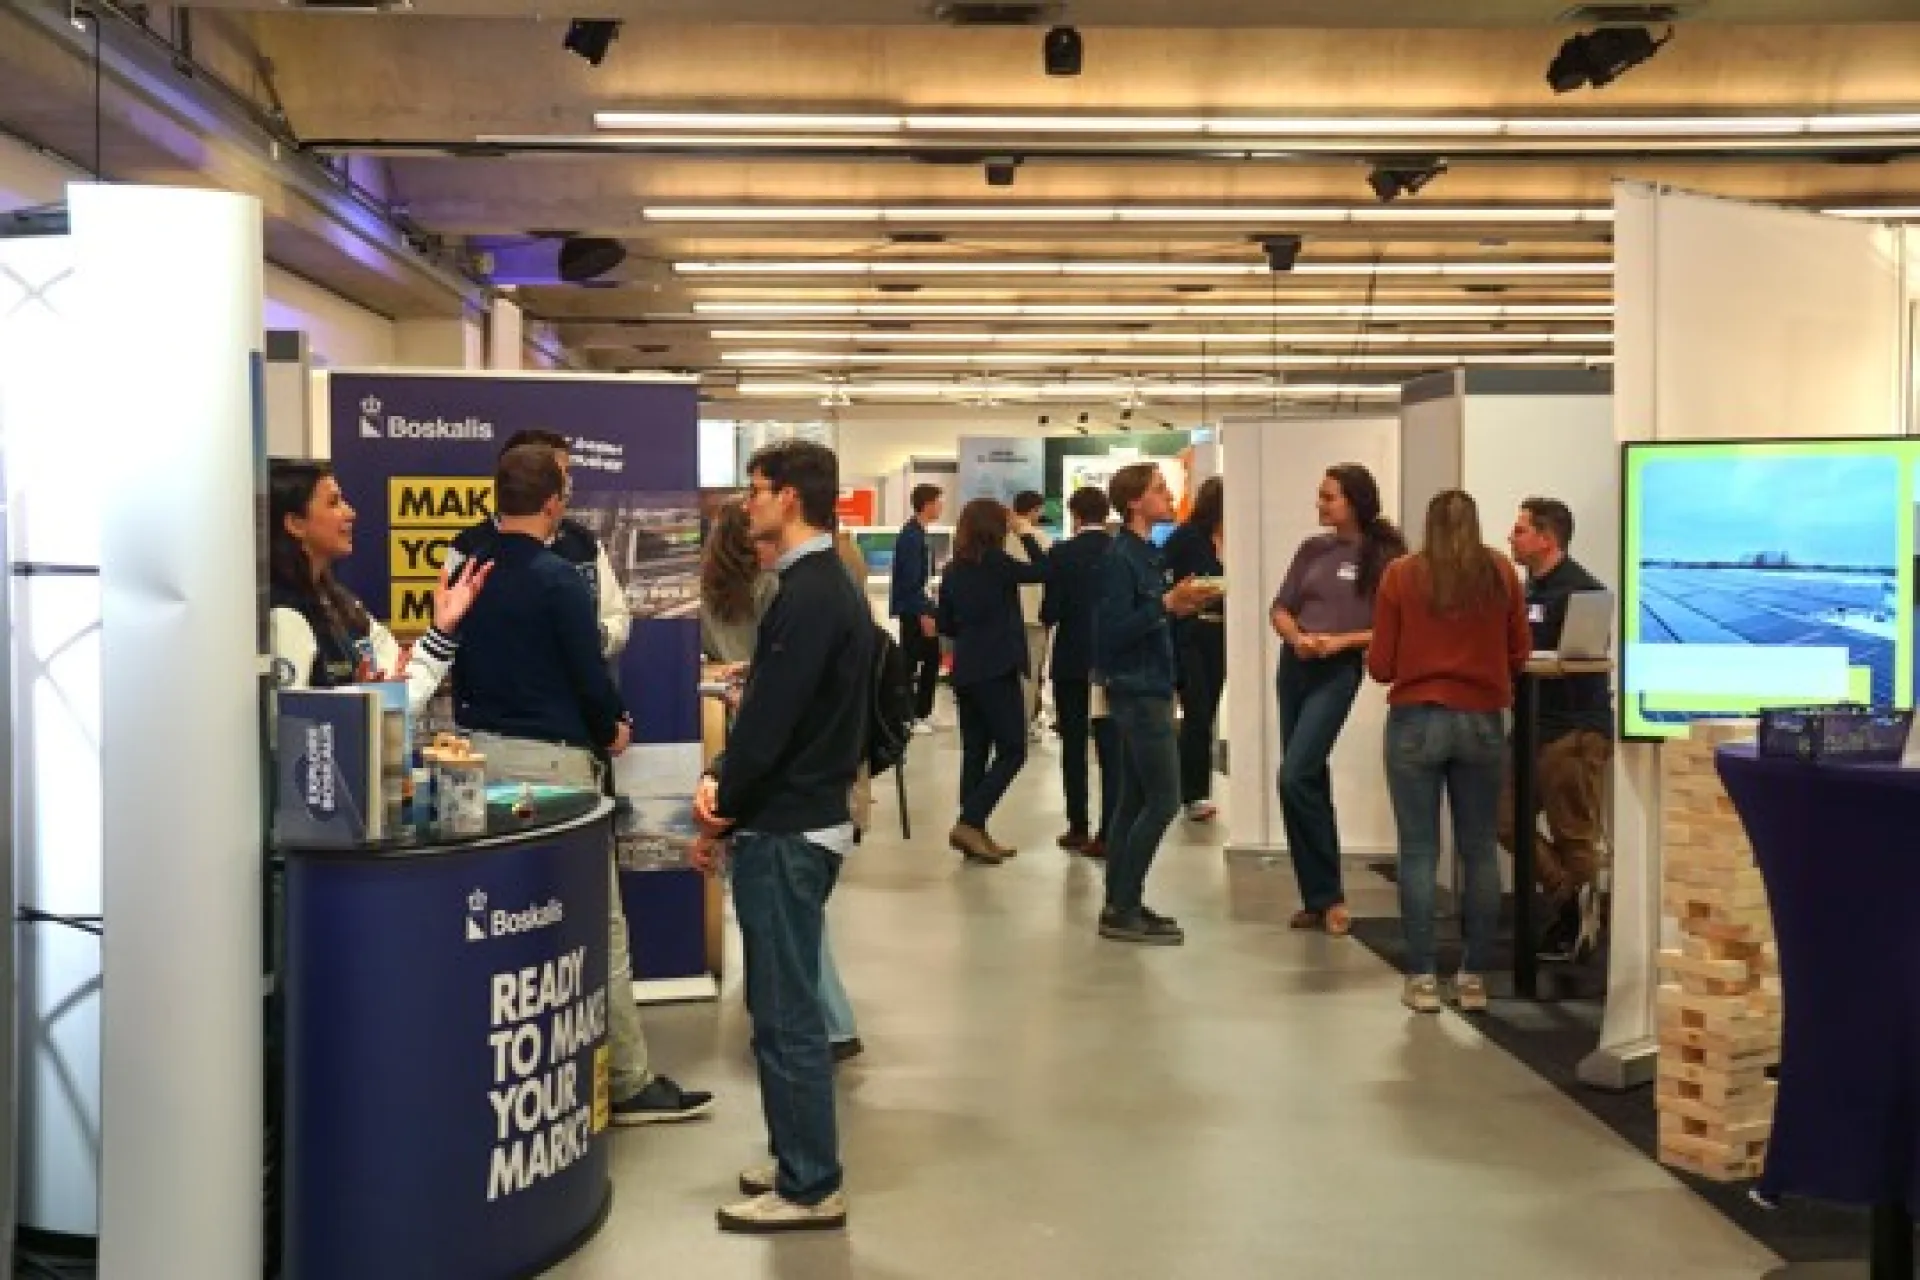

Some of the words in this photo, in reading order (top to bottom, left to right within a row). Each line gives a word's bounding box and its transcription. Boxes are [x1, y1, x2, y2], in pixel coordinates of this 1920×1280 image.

[387, 415, 494, 439] Boskalis
[398, 486, 491, 517] MAK
[398, 536, 451, 570] YO
[490, 897, 564, 937] Boskalis
[491, 946, 587, 1026] READY
[488, 1023, 542, 1083] TO
[487, 1061, 577, 1140] YOUR
[487, 1104, 591, 1202] MARK?
